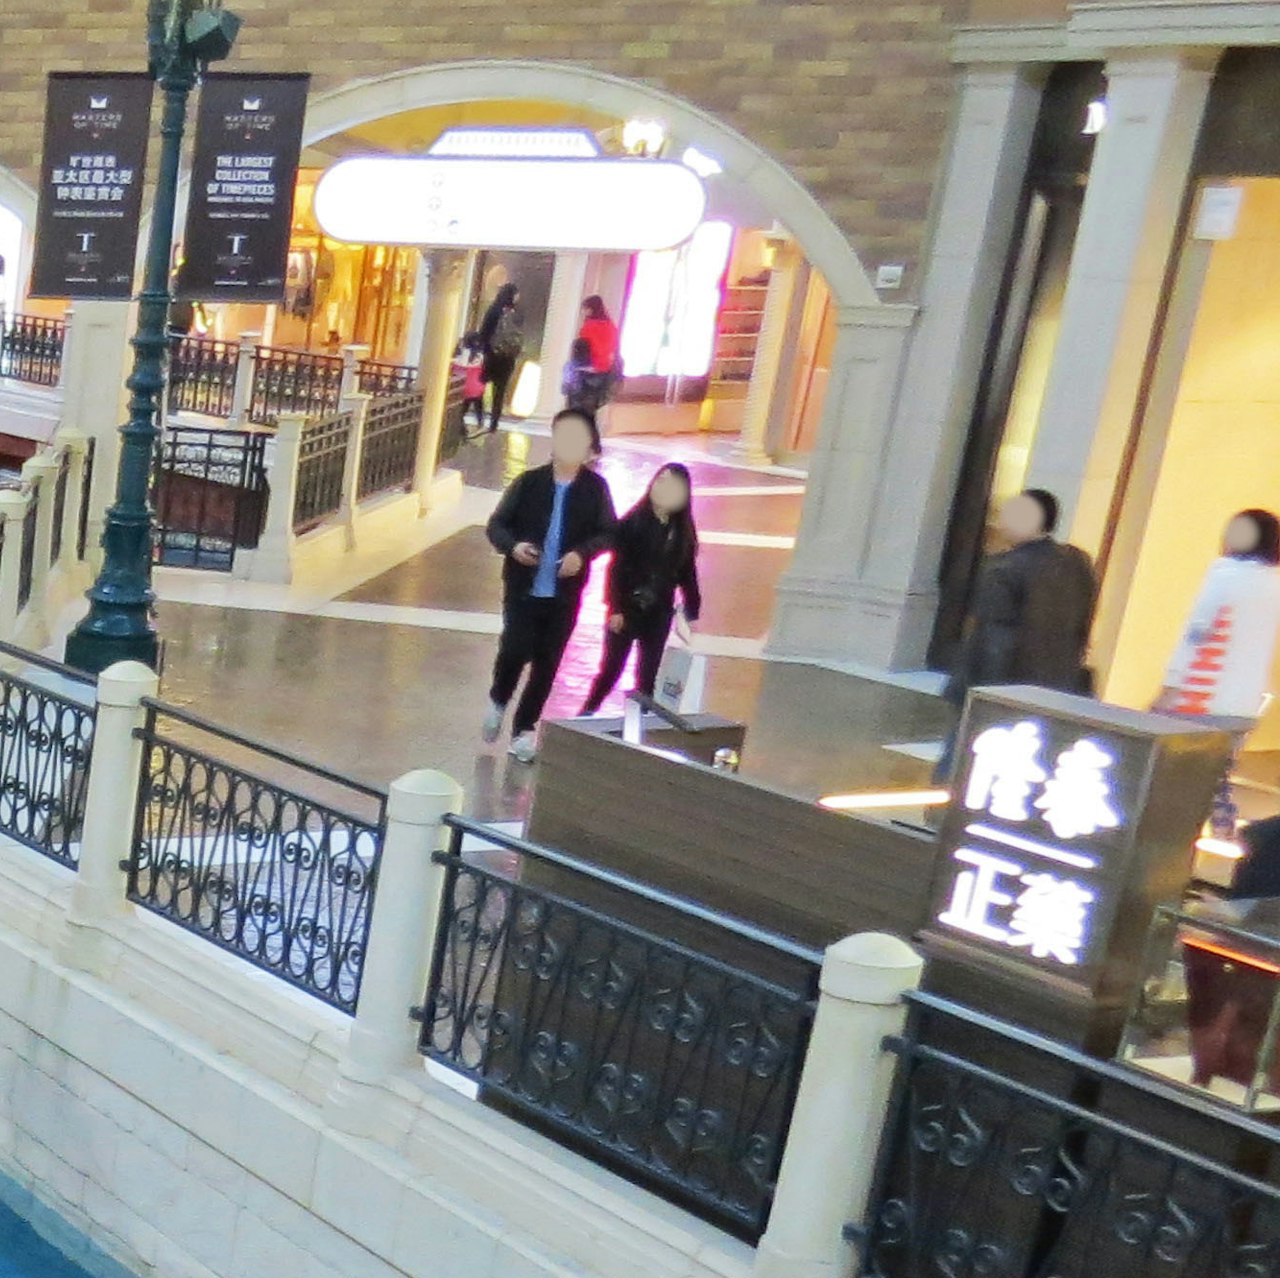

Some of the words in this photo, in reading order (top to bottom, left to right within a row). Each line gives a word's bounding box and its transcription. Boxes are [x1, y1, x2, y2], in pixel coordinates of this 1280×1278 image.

[216, 156, 233, 167] THE
[234, 156, 276, 168] LARGEST
[51, 169, 133, 184] 亚太区最大型
[215, 170, 270, 181] COLLECTION
[207, 183, 220, 195] OF
[221, 183, 275, 196] TIMEPIECES
